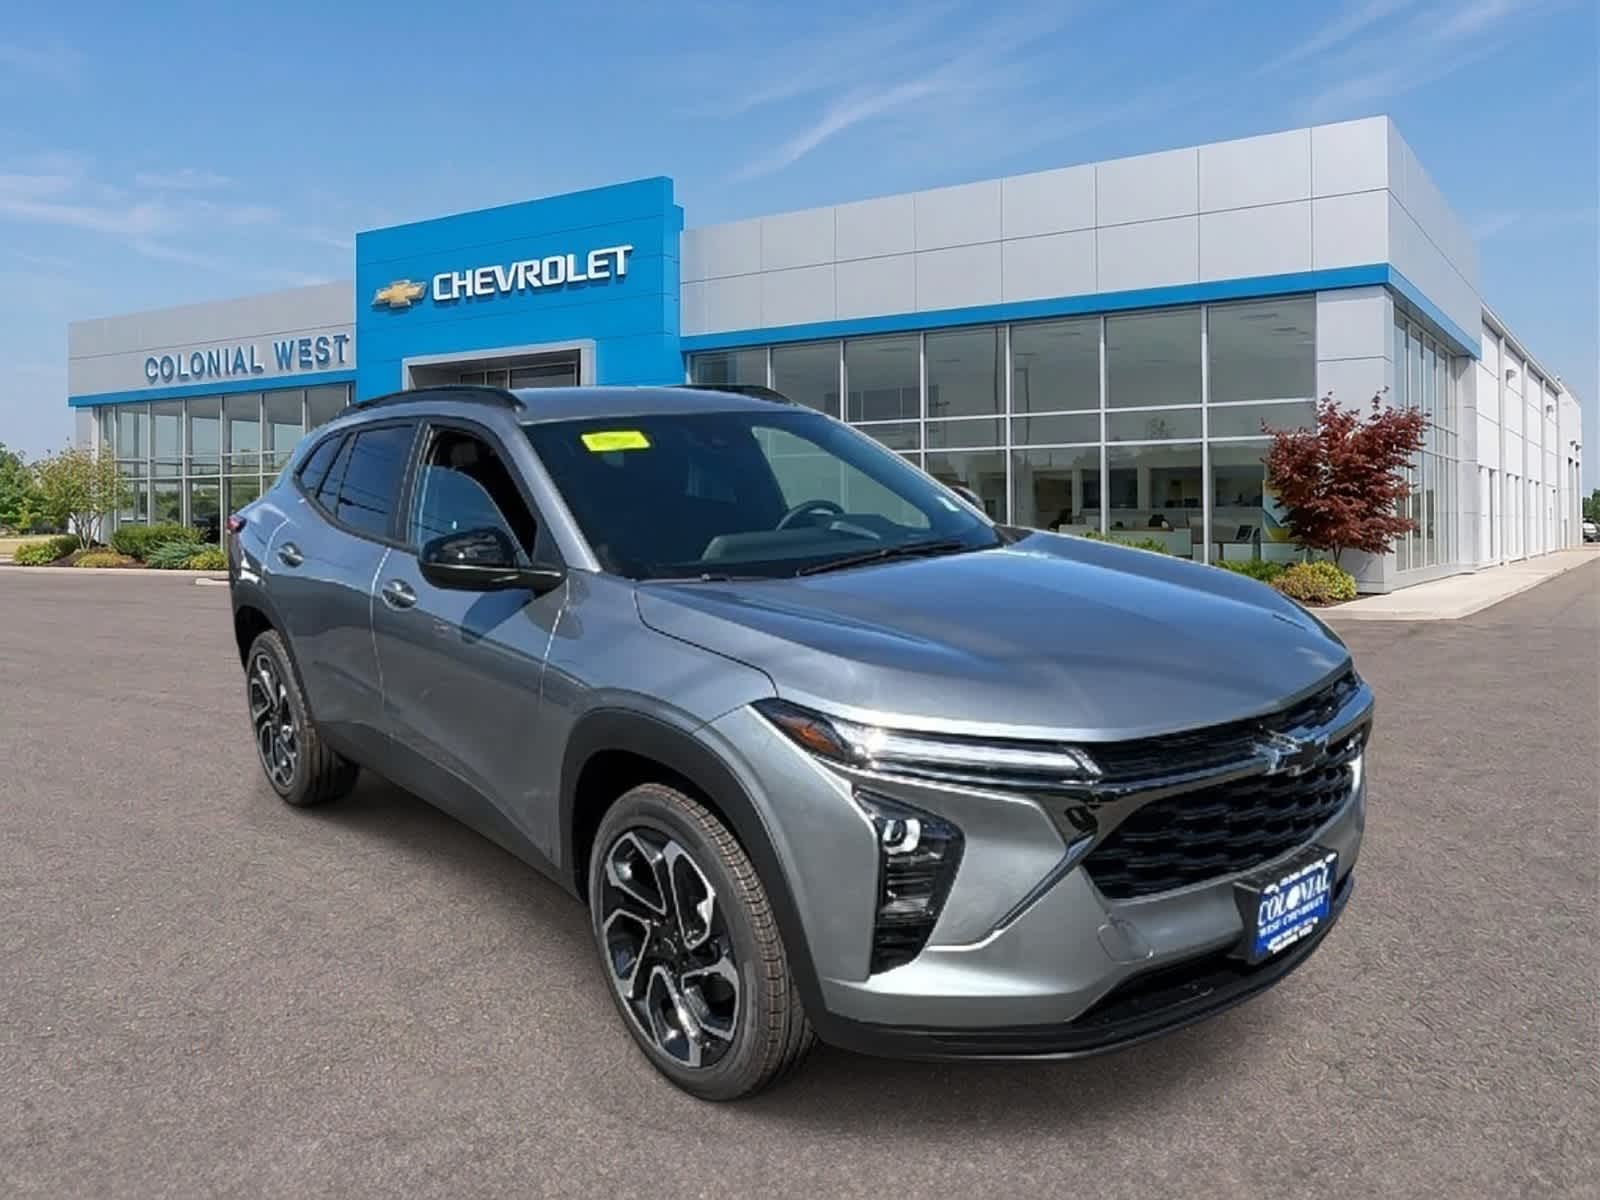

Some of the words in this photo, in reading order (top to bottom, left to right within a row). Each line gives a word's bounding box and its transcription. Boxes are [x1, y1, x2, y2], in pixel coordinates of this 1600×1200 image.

[433, 245, 633, 301] CHEVROLET
[145, 344, 264, 382] COLONIAL
[273, 334, 349, 370] WEST
